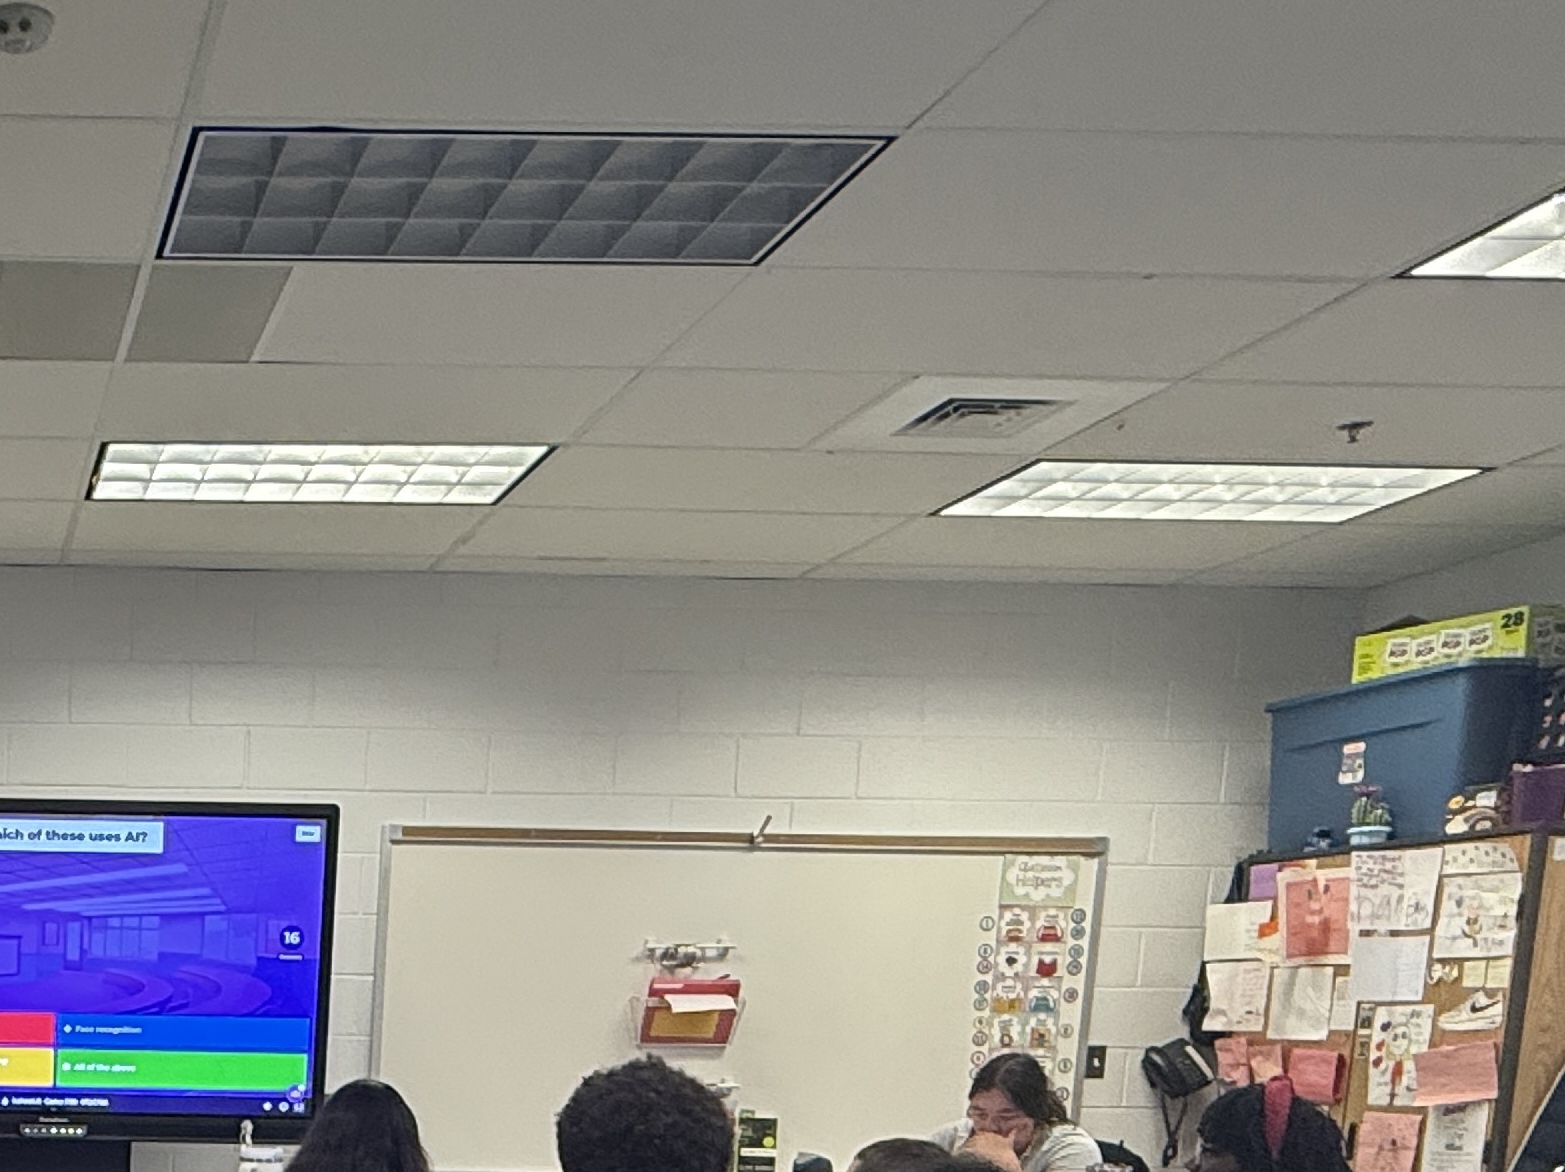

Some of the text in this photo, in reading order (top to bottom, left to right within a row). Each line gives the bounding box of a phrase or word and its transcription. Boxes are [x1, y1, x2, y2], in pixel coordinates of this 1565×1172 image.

[1501, 611, 1526, 629] 28
[28, 829, 43, 841] of
[46, 830, 85, 842] these
[89, 832, 122, 843] uses
[125, 831, 148, 843] AI?
[1015, 873, 1063, 890] Helpers
[283, 931, 301, 945] 16
